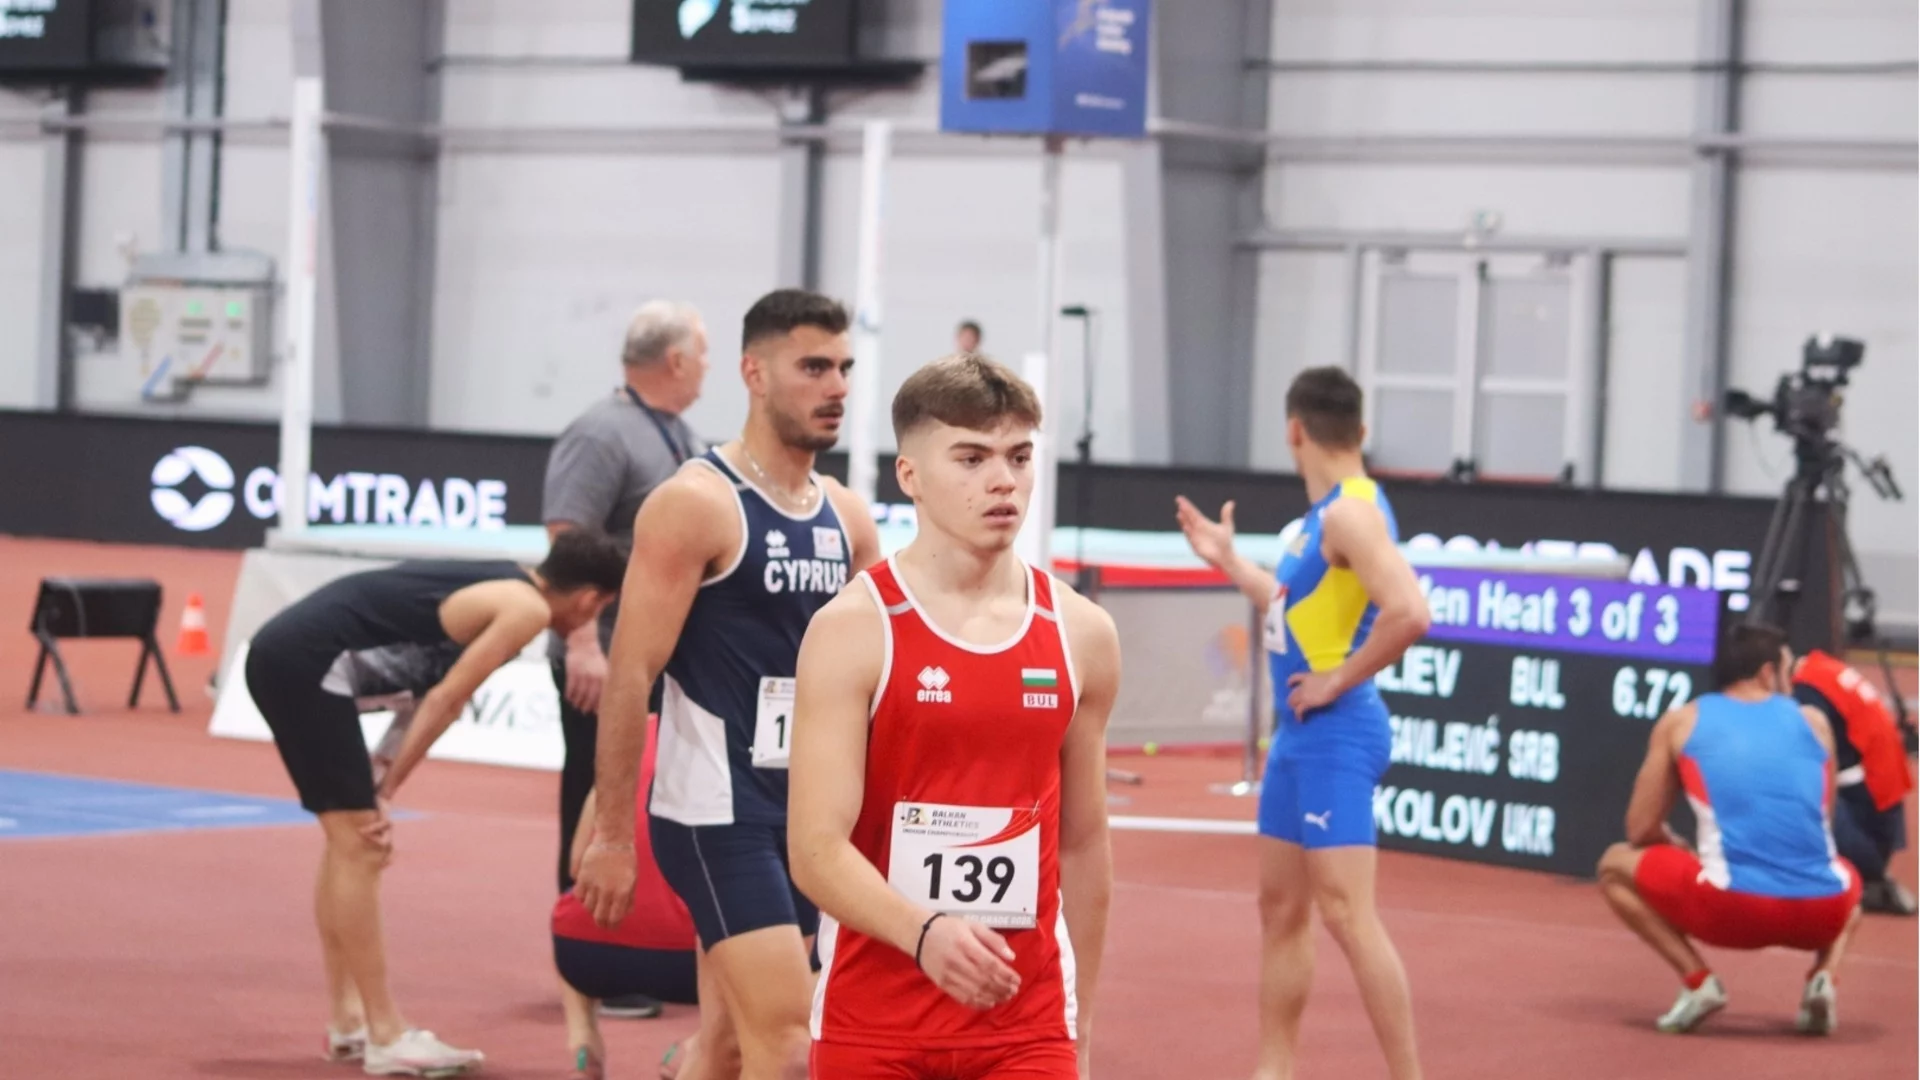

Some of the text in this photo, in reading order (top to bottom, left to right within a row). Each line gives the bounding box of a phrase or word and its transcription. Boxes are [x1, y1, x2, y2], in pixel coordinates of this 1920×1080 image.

[764, 559, 847, 594] CYPRUS
[1477, 580, 1557, 635] Heat
[1568, 587, 1591, 637] 3
[1602, 592, 1644, 641] of
[1654, 594, 1679, 645] 3
[1027, 695, 1054, 706] BUL
[1510, 656, 1565, 709] BUL
[1612, 666, 1692, 719] 6.72
[1508, 729, 1559, 782] SRB
[931, 818, 979, 829] ATHLETICS
[932, 809, 966, 819] BALKAN
[1372, 784, 1555, 856] KOLOV UKR
[923, 852, 1015, 904] 139
